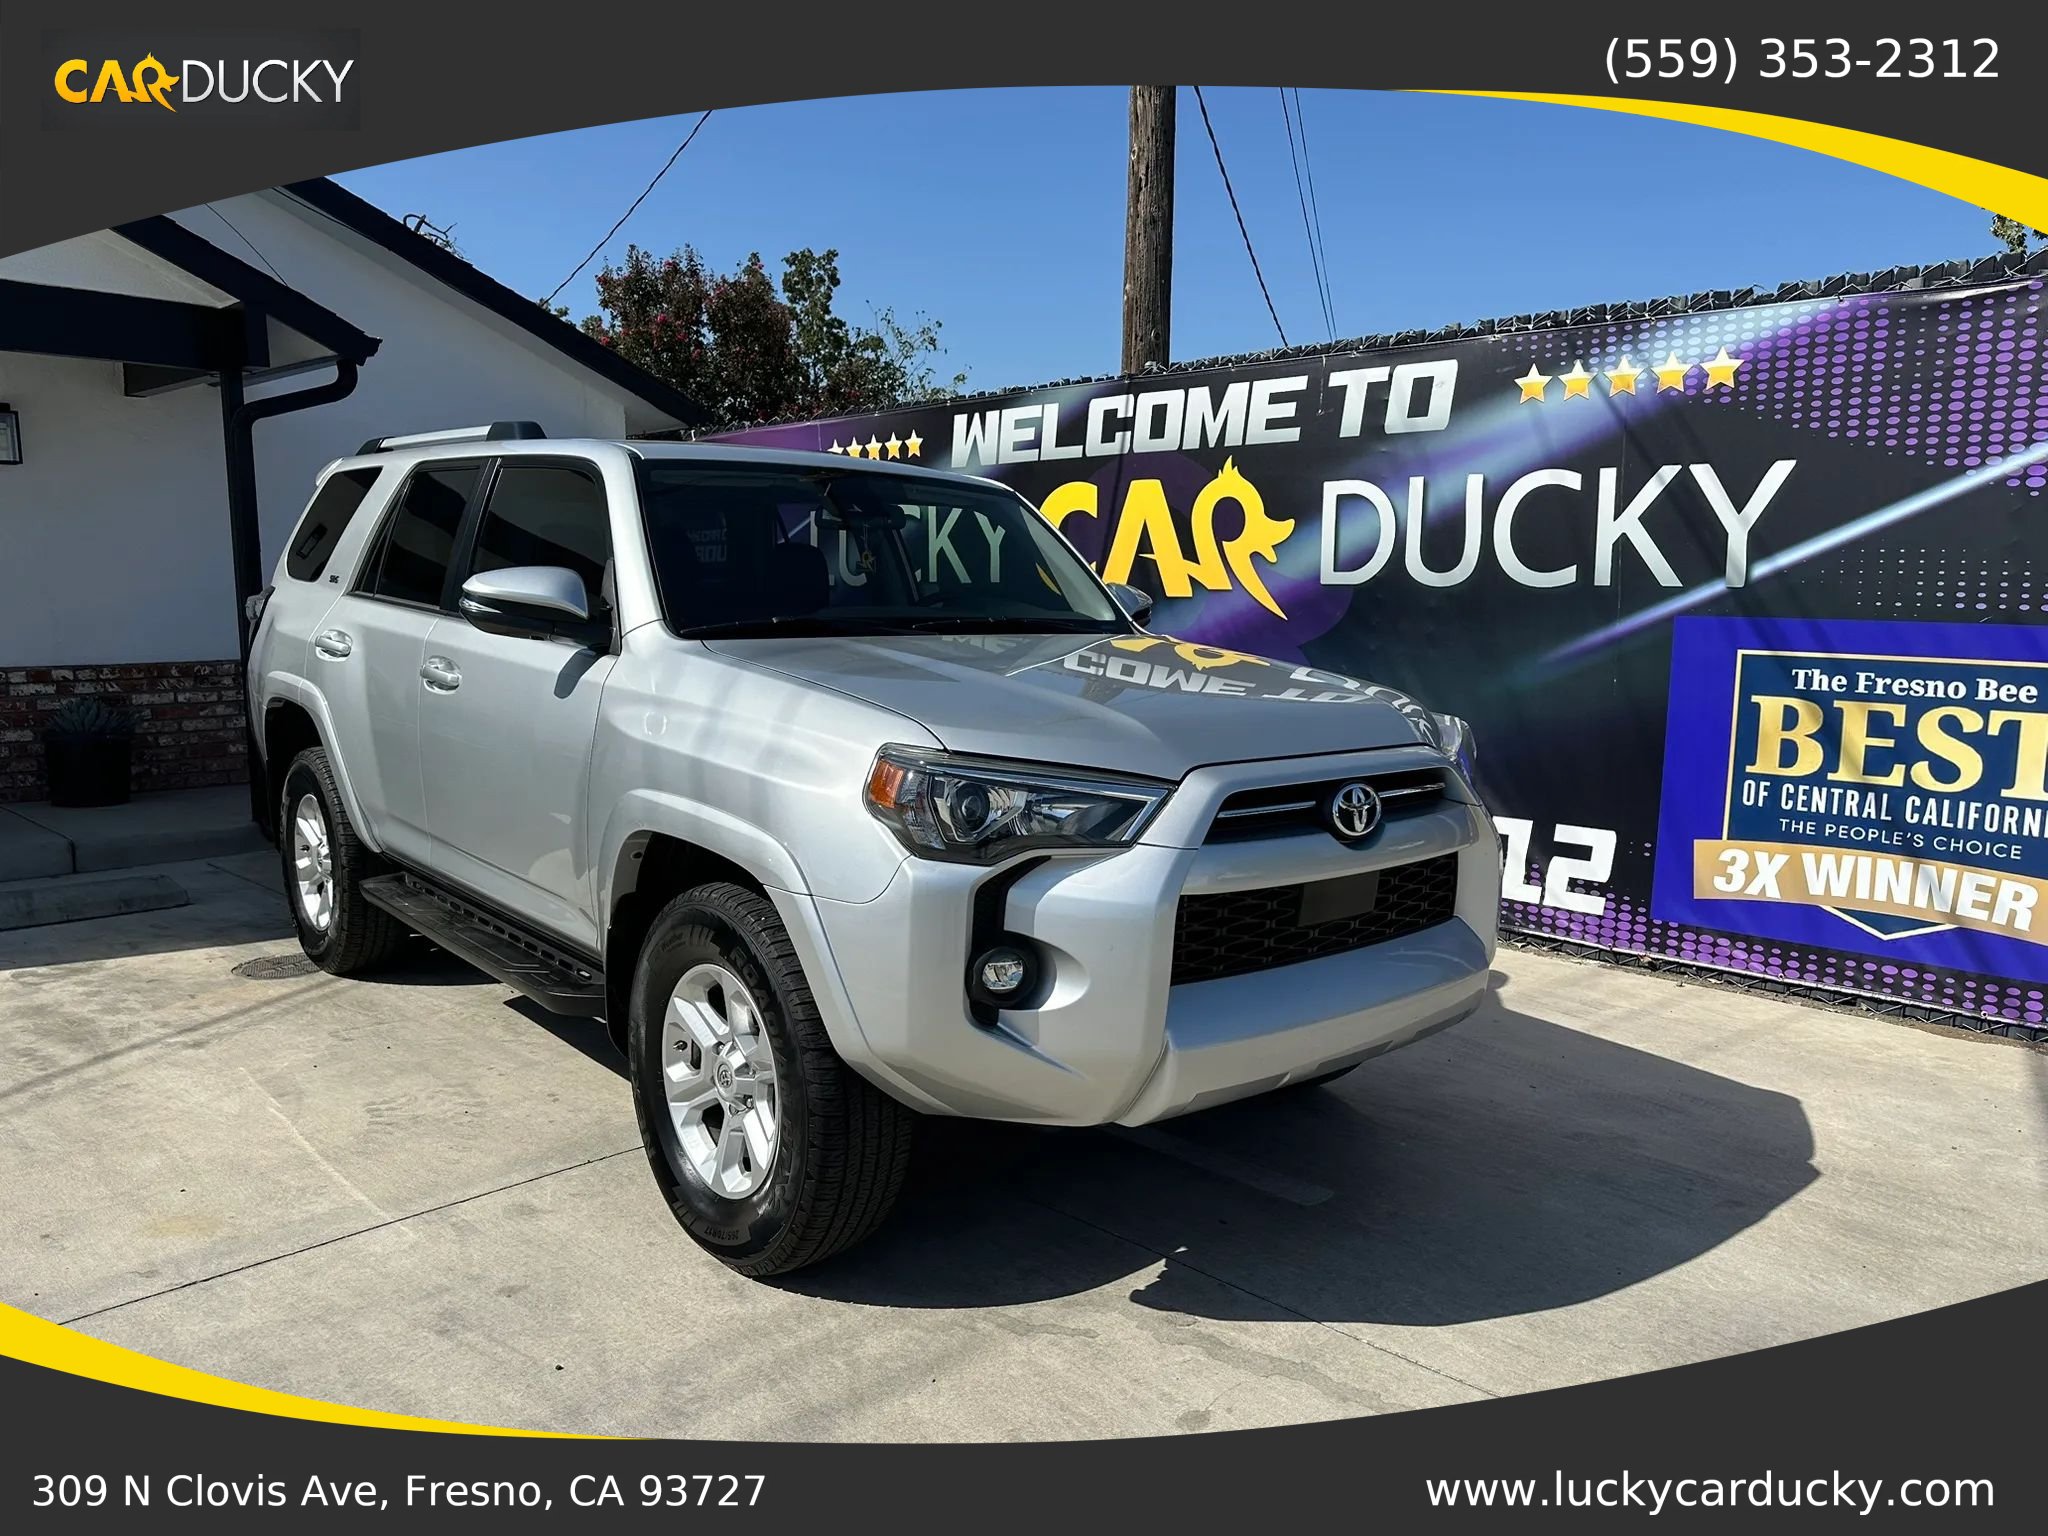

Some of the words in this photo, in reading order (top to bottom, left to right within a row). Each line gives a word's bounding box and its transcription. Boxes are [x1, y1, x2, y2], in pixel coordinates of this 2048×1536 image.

[952, 374, 1309, 469] WELCOME
[1327, 358, 1460, 437] TO
[1319, 459, 1797, 589] DUCKY
[1791, 668, 1848, 692] The
[1855, 671, 1967, 699] Fresno
[1974, 678, 2039, 704] Bee
[1745, 695, 2048, 801] BEST
[1742, 779, 1771, 808] OF
[1780, 783, 1893, 821] CENTRAL
[1779, 818, 1817, 835] THE
[1825, 823, 1925, 848] PEOPLE'S
[1933, 836, 2022, 860] CHOICE
[1713, 848, 1790, 899] 3X
[1801, 853, 2039, 932] WINNER
